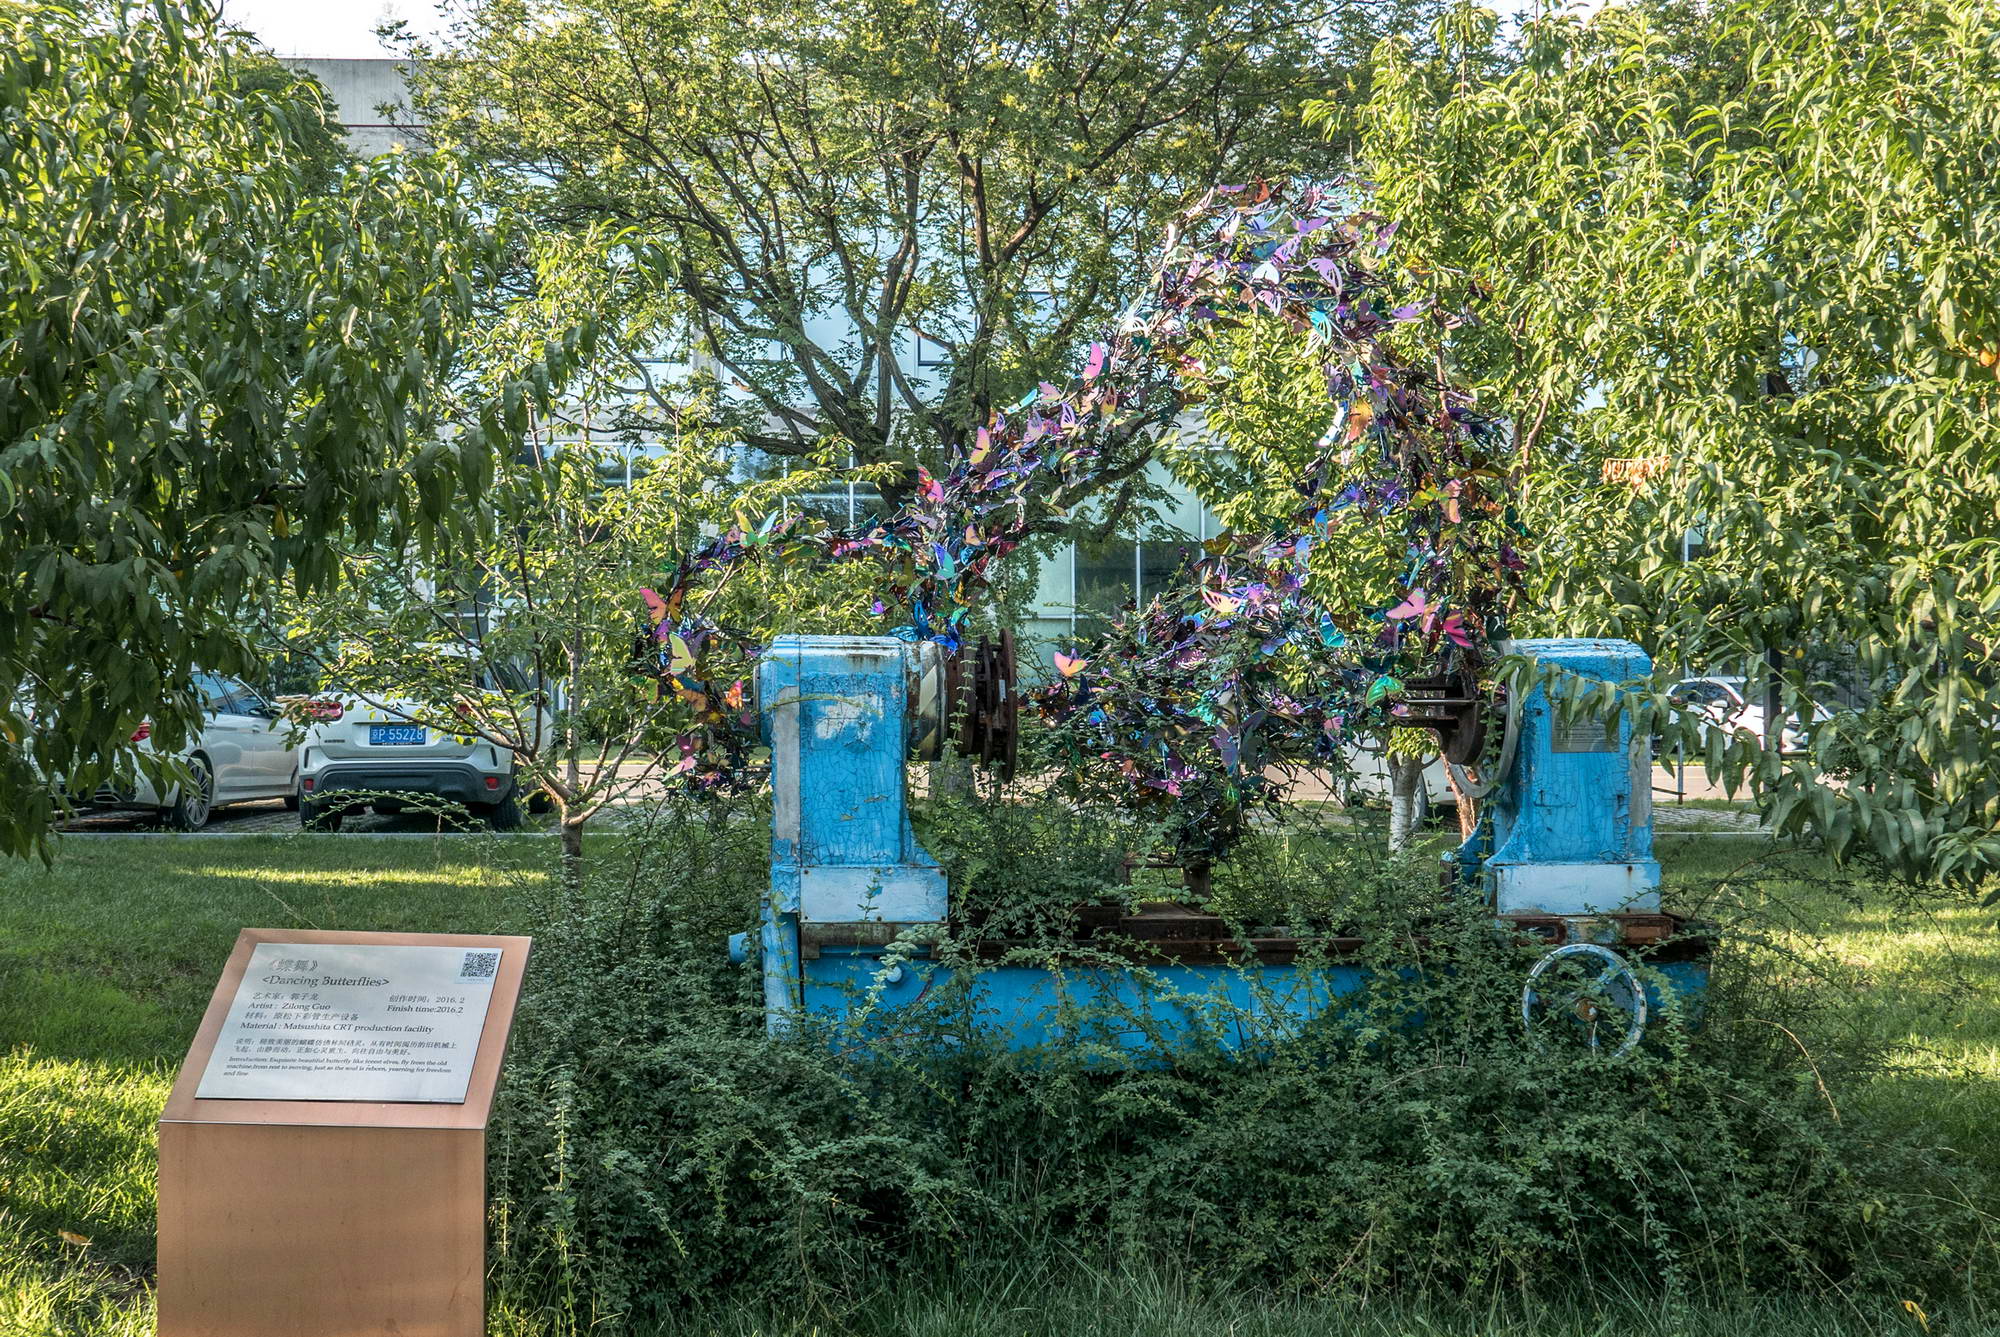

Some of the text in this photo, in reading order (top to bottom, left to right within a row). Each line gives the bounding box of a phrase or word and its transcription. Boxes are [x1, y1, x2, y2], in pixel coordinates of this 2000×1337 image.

[271, 959, 318, 972] 《蝶舞》
[262, 975, 390, 988] <Dancing Butterflies>
[281, 1002, 311, 1011] Zilong
[312, 1002, 331, 1010] Guo
[240, 1022, 277, 1030] Material
[333, 1023, 353, 1031] CRT
[354, 1024, 402, 1032] production
[404, 1025, 434, 1035] facility
